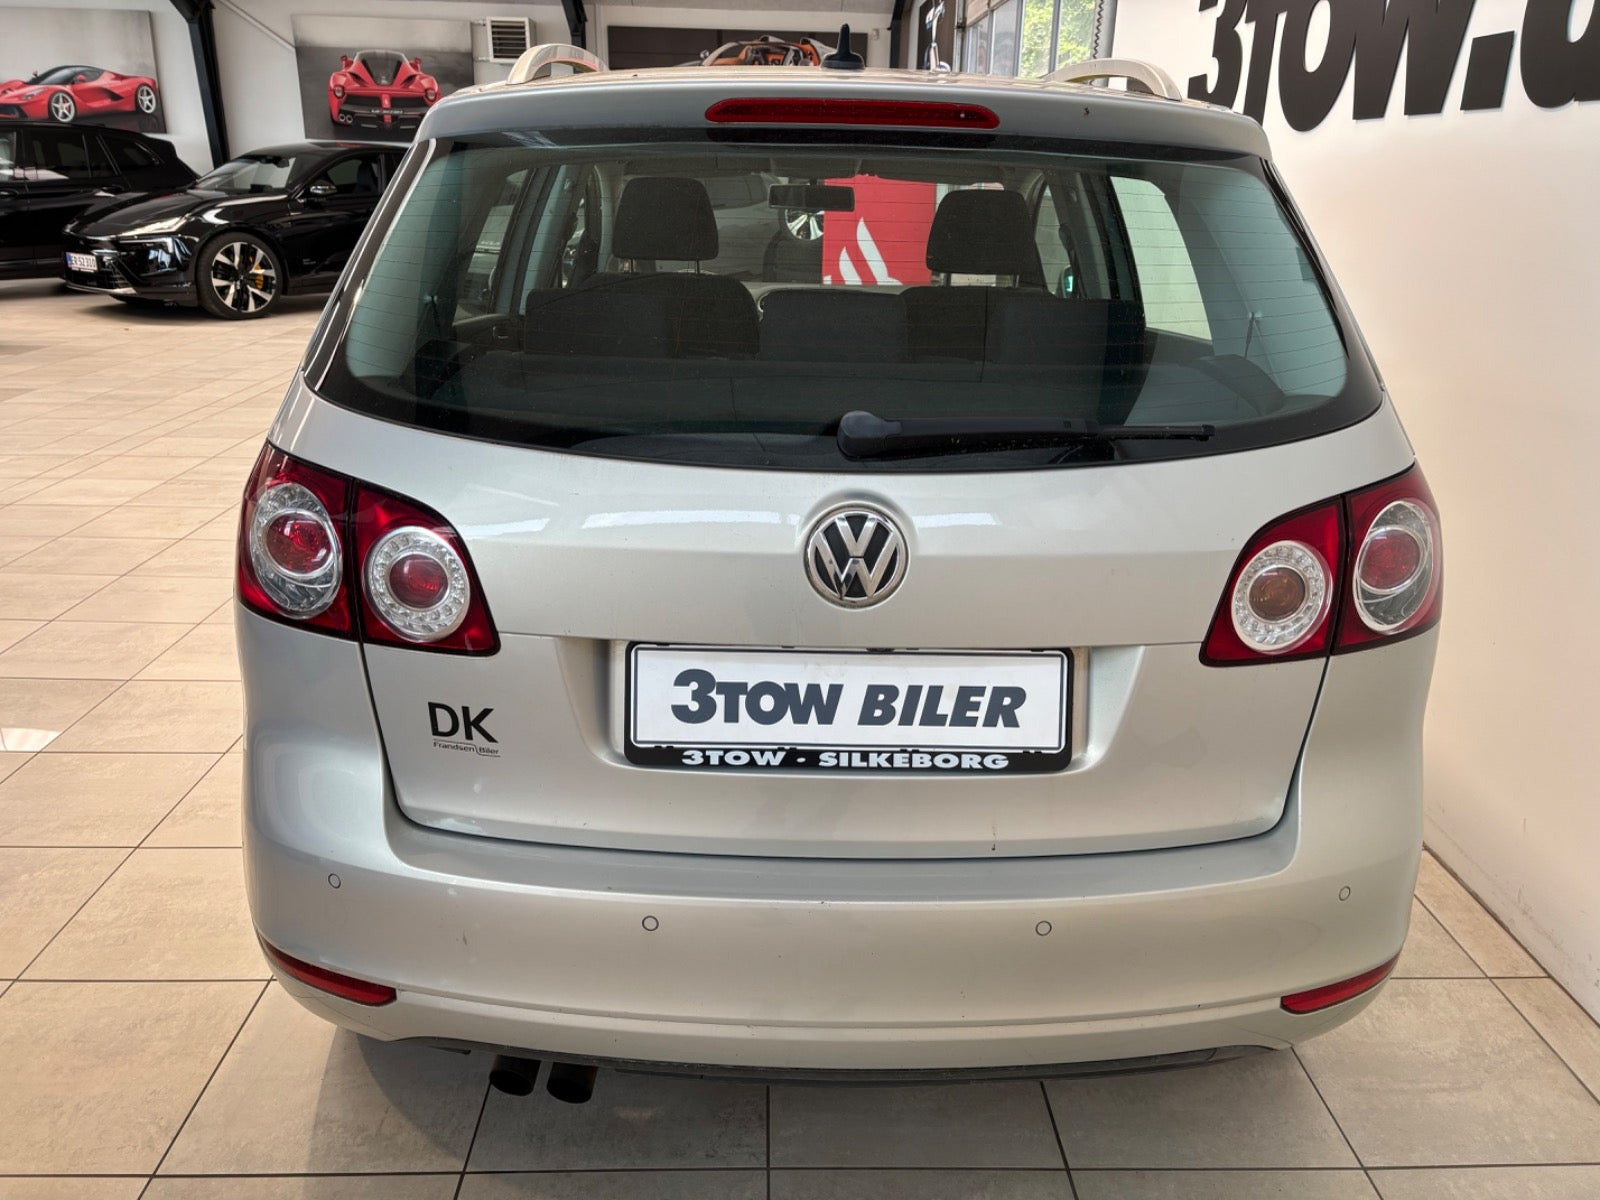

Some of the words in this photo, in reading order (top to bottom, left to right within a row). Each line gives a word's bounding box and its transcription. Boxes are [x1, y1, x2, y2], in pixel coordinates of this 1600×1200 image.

[671, 668, 844, 726] 3TOW
[857, 683, 1027, 729] BILER
[428, 701, 499, 743] DK
[433, 741, 475, 752] Frandsen
[479, 746, 499, 754] Biler
[681, 749, 787, 768] 3TOW
[818, 751, 1009, 770] SILKEBORG
